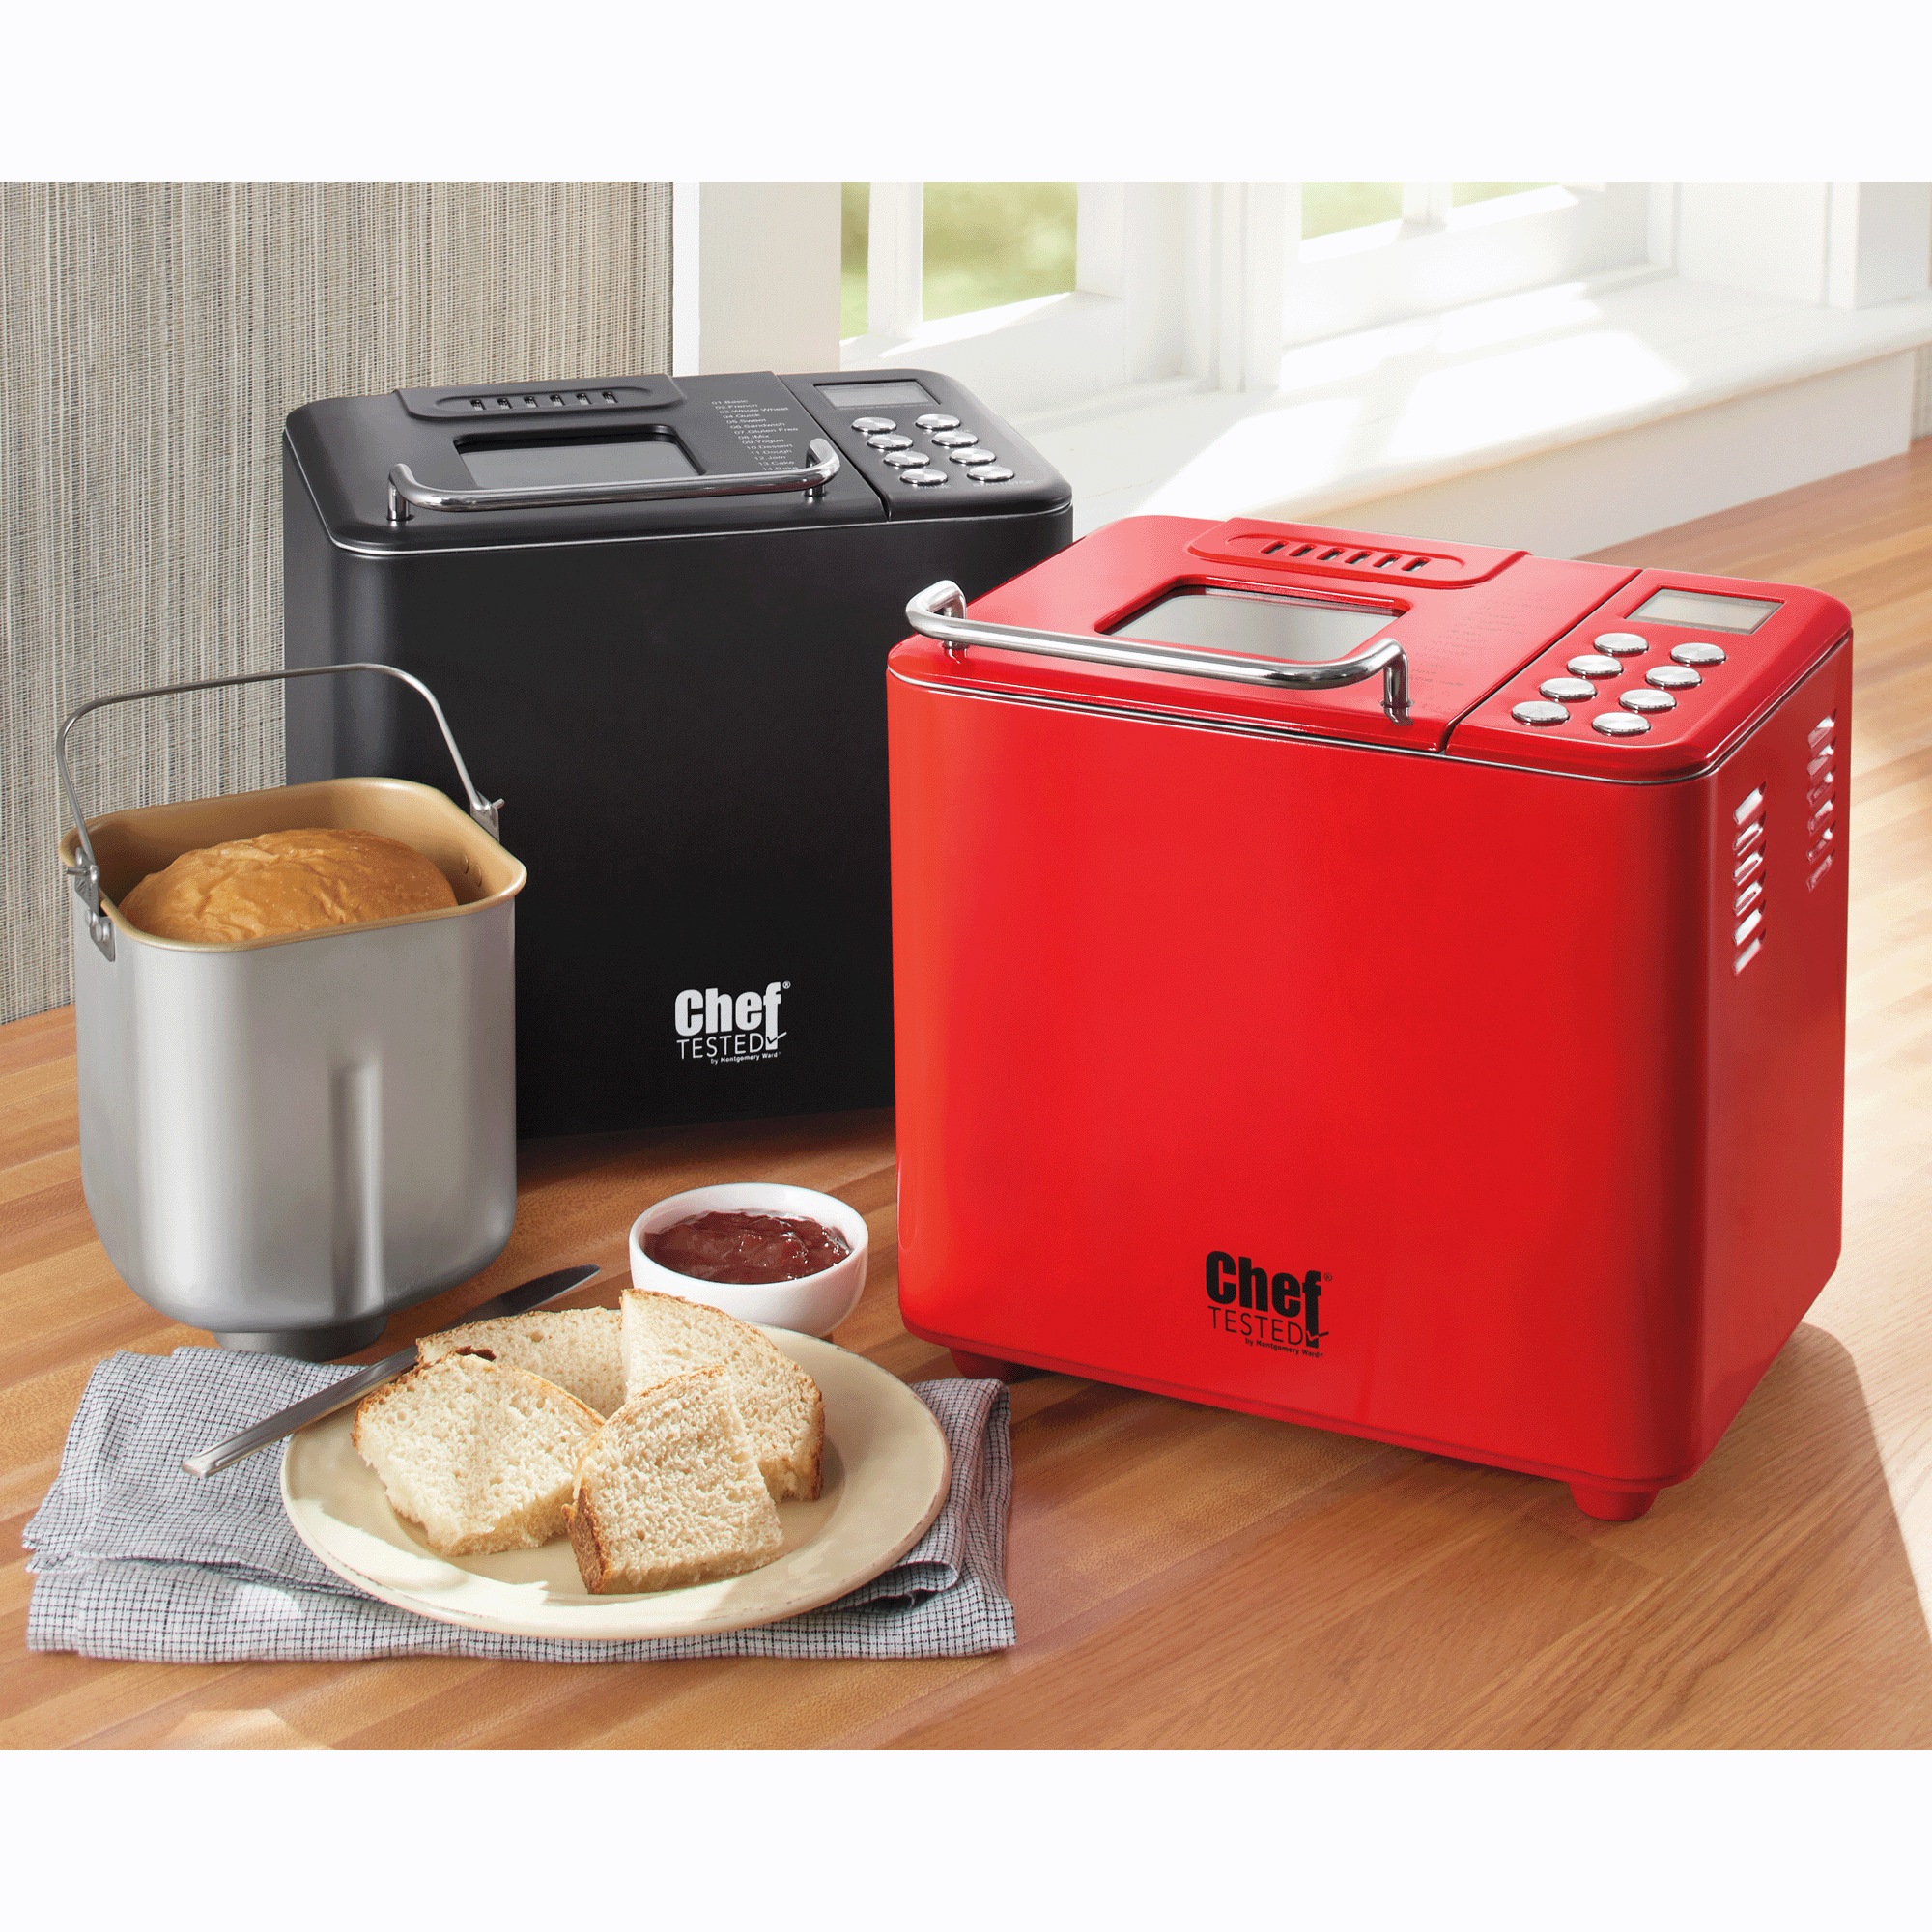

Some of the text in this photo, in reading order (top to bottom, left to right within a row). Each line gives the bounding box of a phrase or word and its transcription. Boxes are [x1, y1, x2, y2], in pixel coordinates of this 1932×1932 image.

[674, 981, 781, 1051] Chef
[676, 1033, 764, 1060] TESTED
[720, 1054, 760, 1063] Montgomery
[1206, 1250, 1322, 1349] Chef
[1208, 1305, 1303, 1346] TESTED
[1244, 1338, 1320, 1358] by Montgomery Ward
